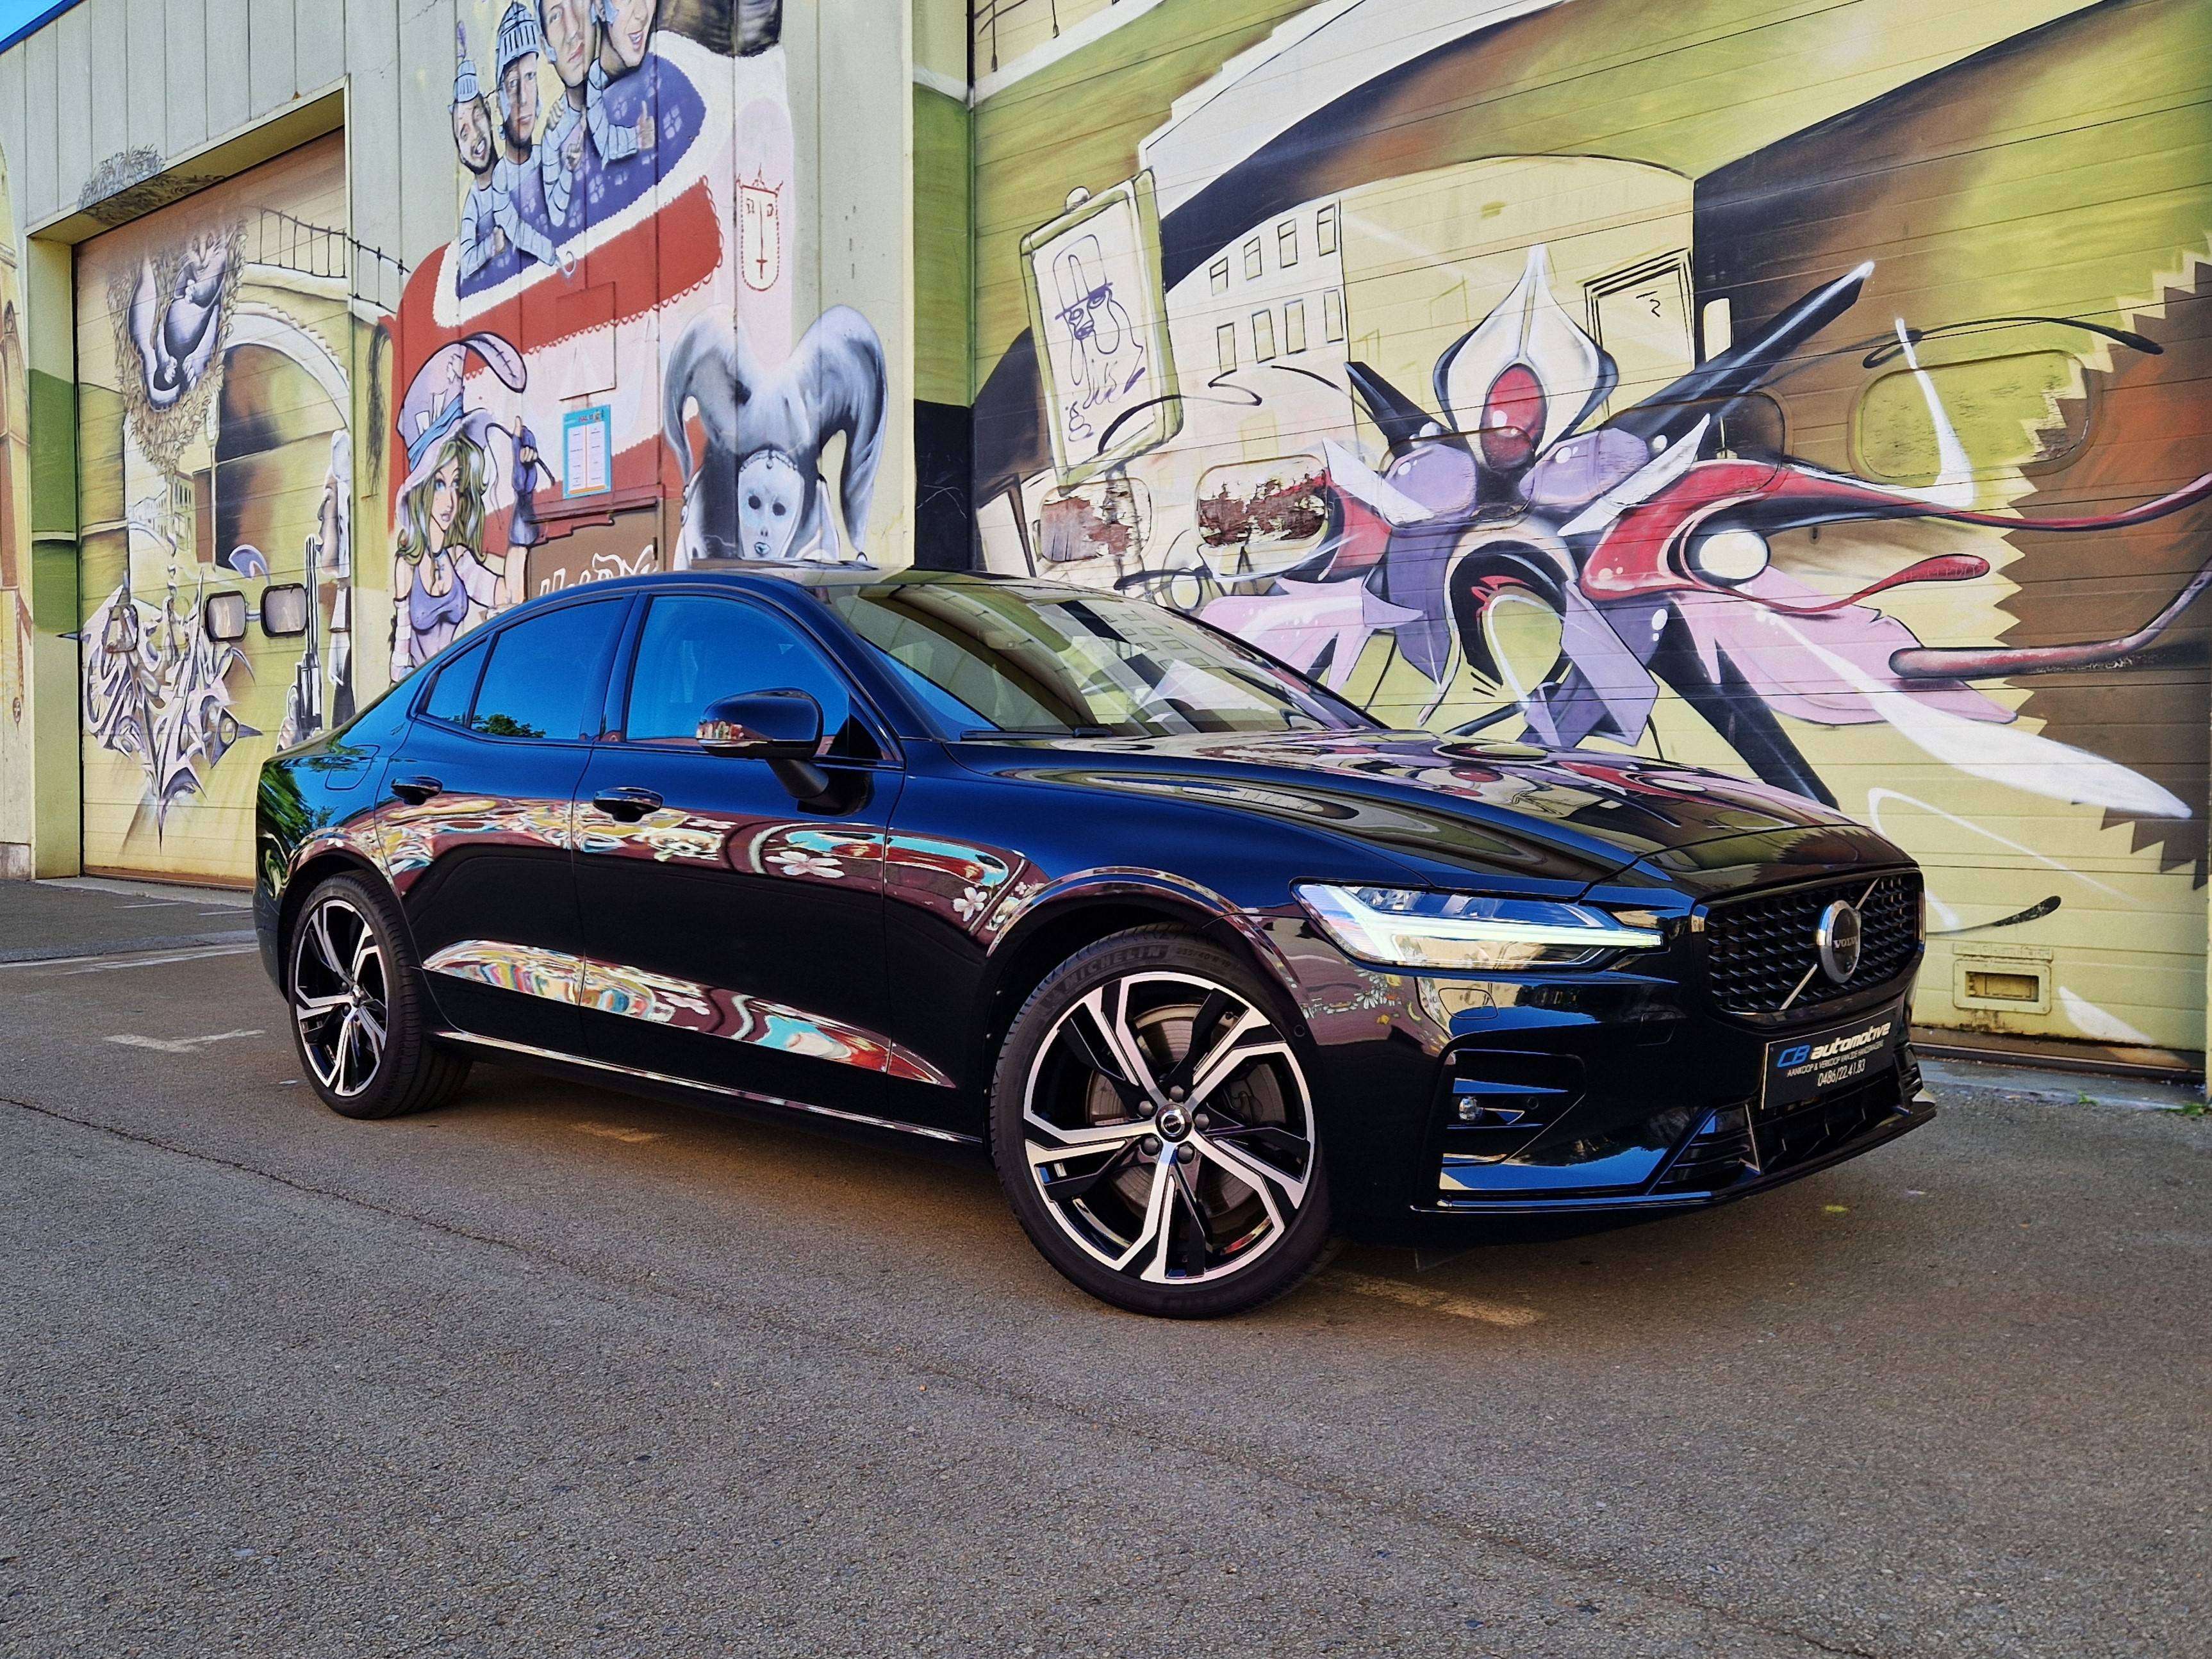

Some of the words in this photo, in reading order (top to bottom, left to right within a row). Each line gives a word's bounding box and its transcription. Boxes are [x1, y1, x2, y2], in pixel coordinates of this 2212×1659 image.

[1064, 946, 1160, 991] MICHELIN
[1777, 1044, 1811, 1068] CB
[1810, 1022, 1891, 1060] automotive
[1787, 1062, 1814, 1077] AANKOOP
[1817, 1059, 1866, 1087] 0486/22.41.83
